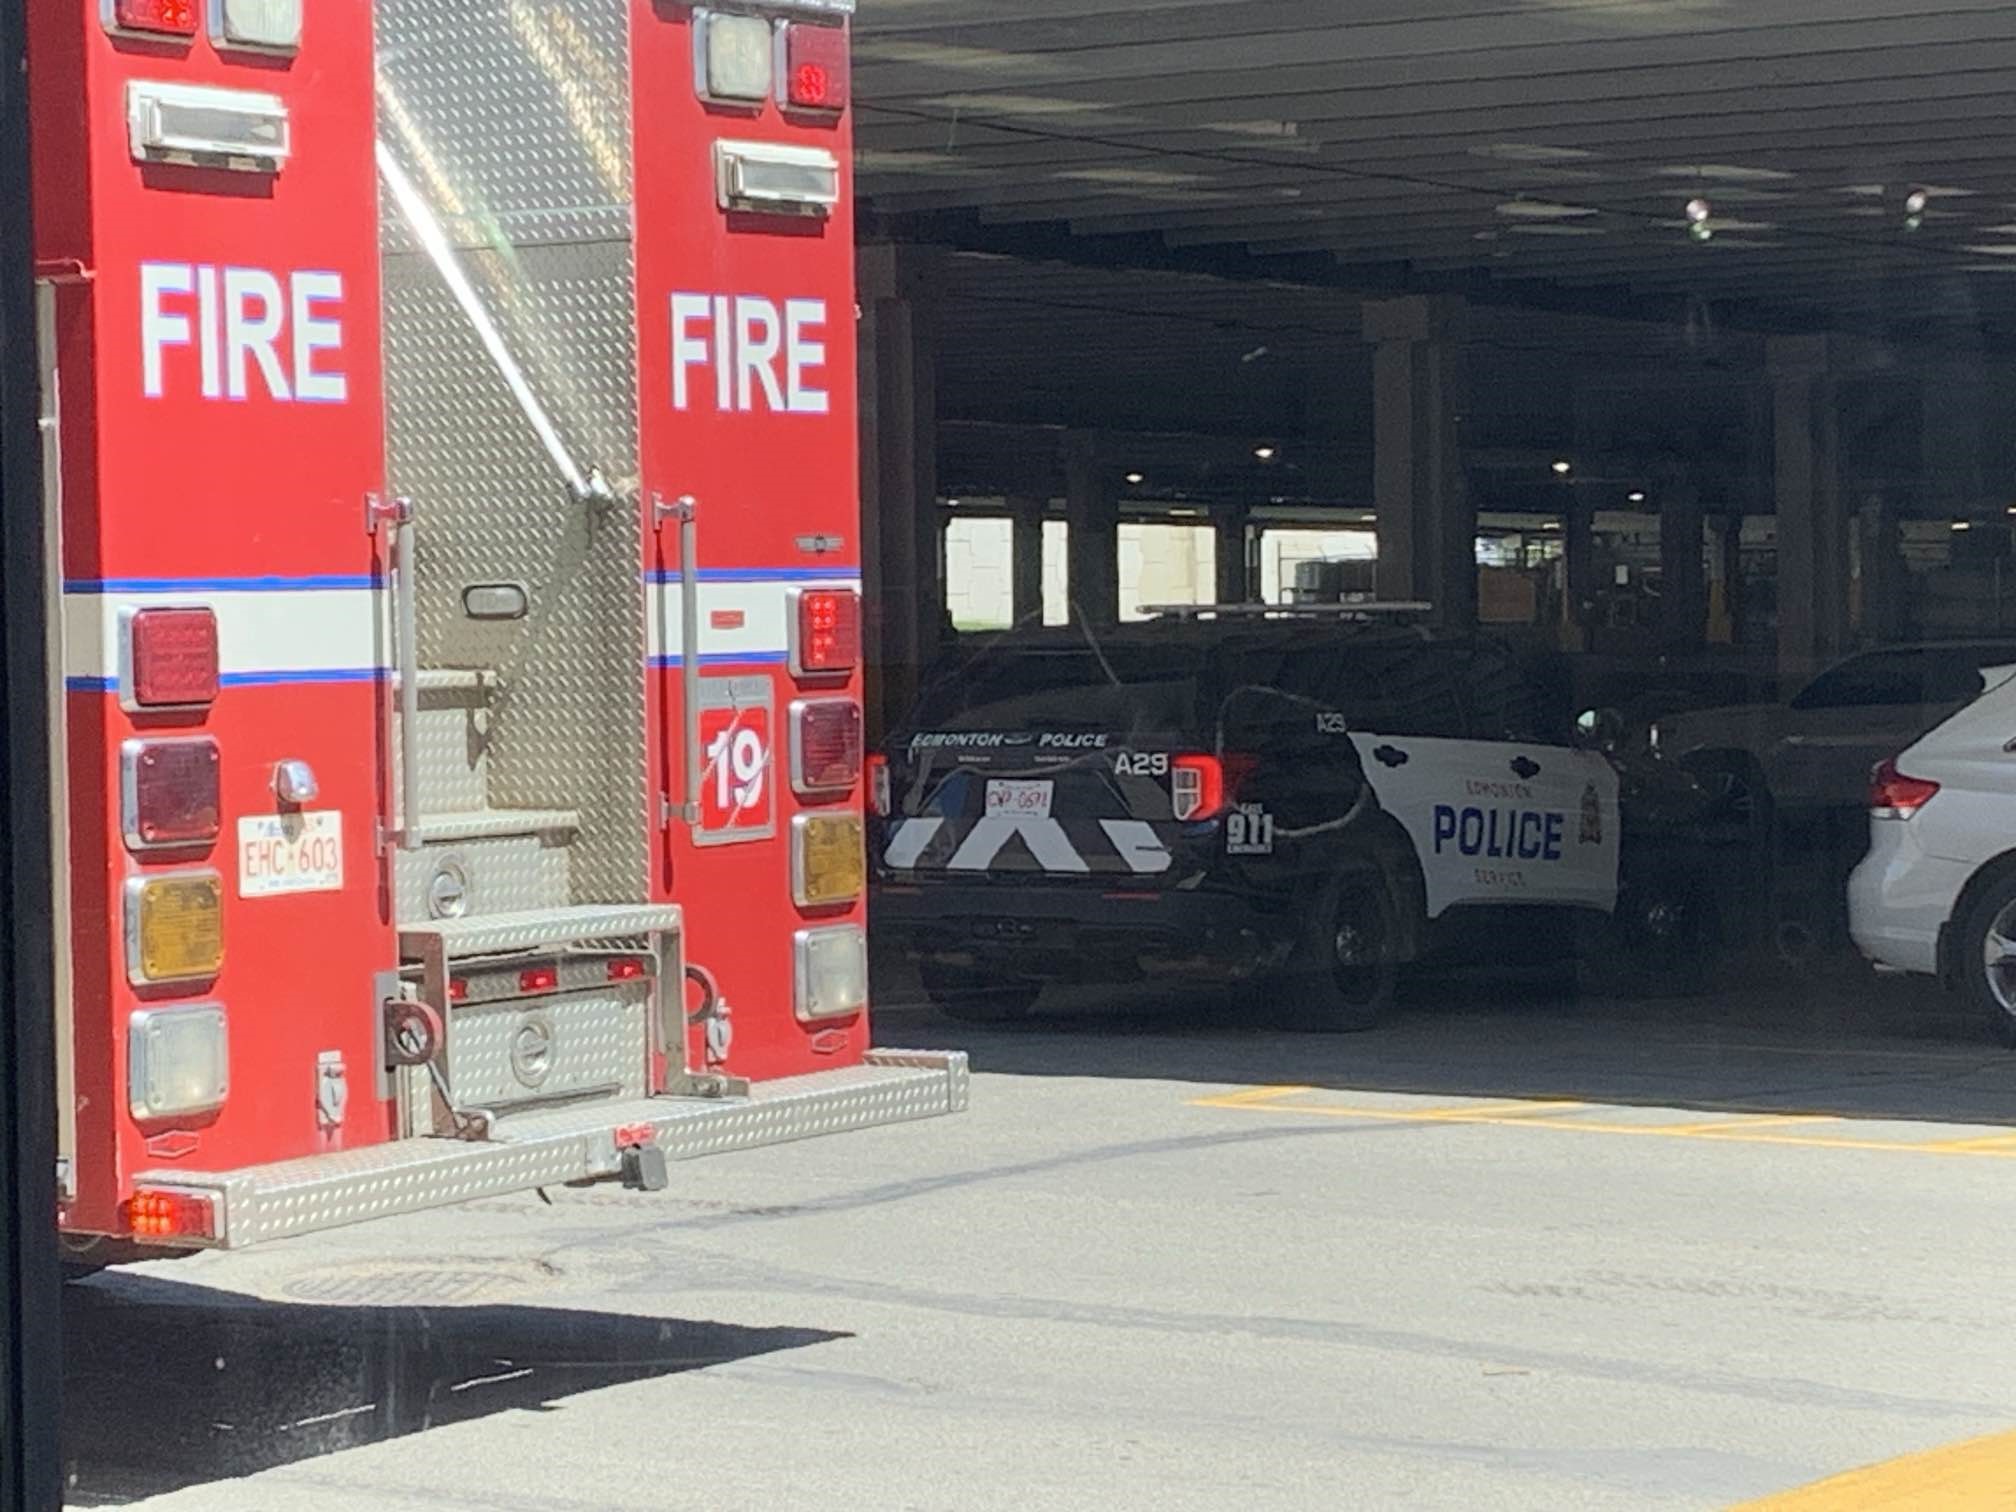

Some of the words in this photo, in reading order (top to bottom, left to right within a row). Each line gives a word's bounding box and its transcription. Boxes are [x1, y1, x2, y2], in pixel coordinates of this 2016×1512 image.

[140, 261, 348, 403] FIRE
[668, 290, 829, 414] FIRE
[707, 729, 764, 809] 19
[910, 732, 1005, 747] EDMONTON
[1038, 732, 1108, 748] POLICE
[1115, 752, 1169, 776] A29
[1226, 813, 1273, 844] 911
[1433, 803, 1565, 861] POLICE
